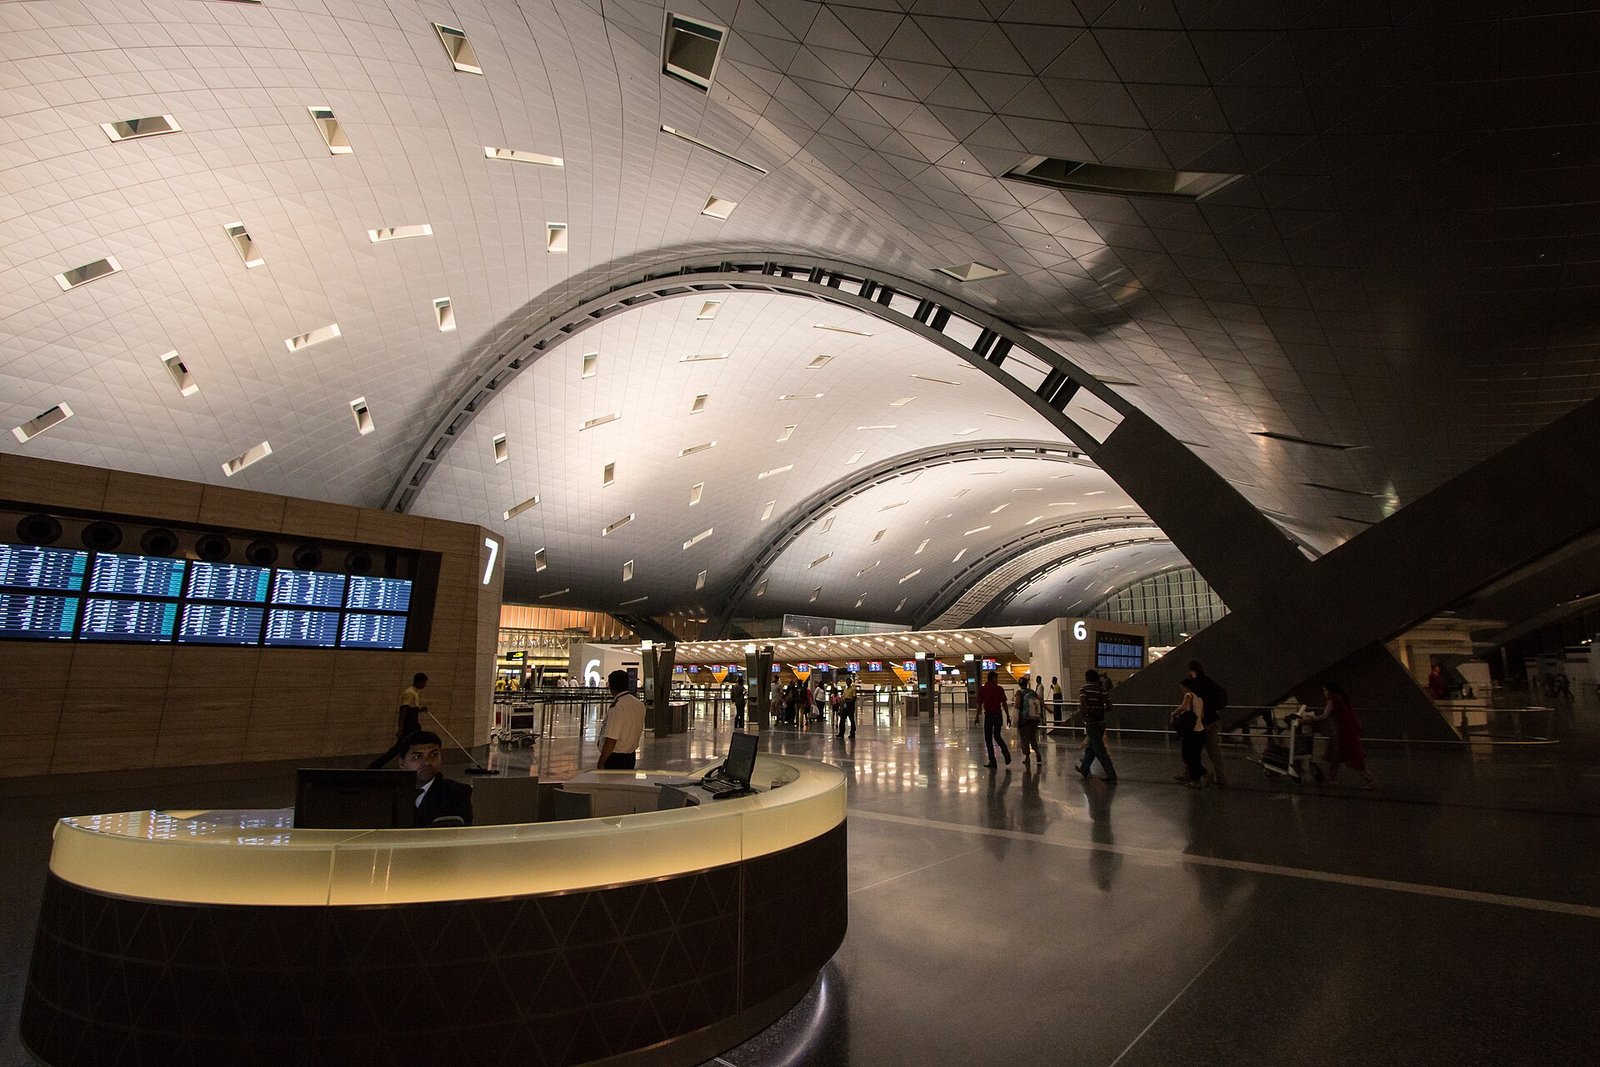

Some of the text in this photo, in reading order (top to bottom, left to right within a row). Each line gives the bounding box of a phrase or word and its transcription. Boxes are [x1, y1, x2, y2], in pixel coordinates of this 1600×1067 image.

[483, 537, 499, 585] 7
[1073, 620, 1087, 640] 6
[585, 659, 601, 688] 6
